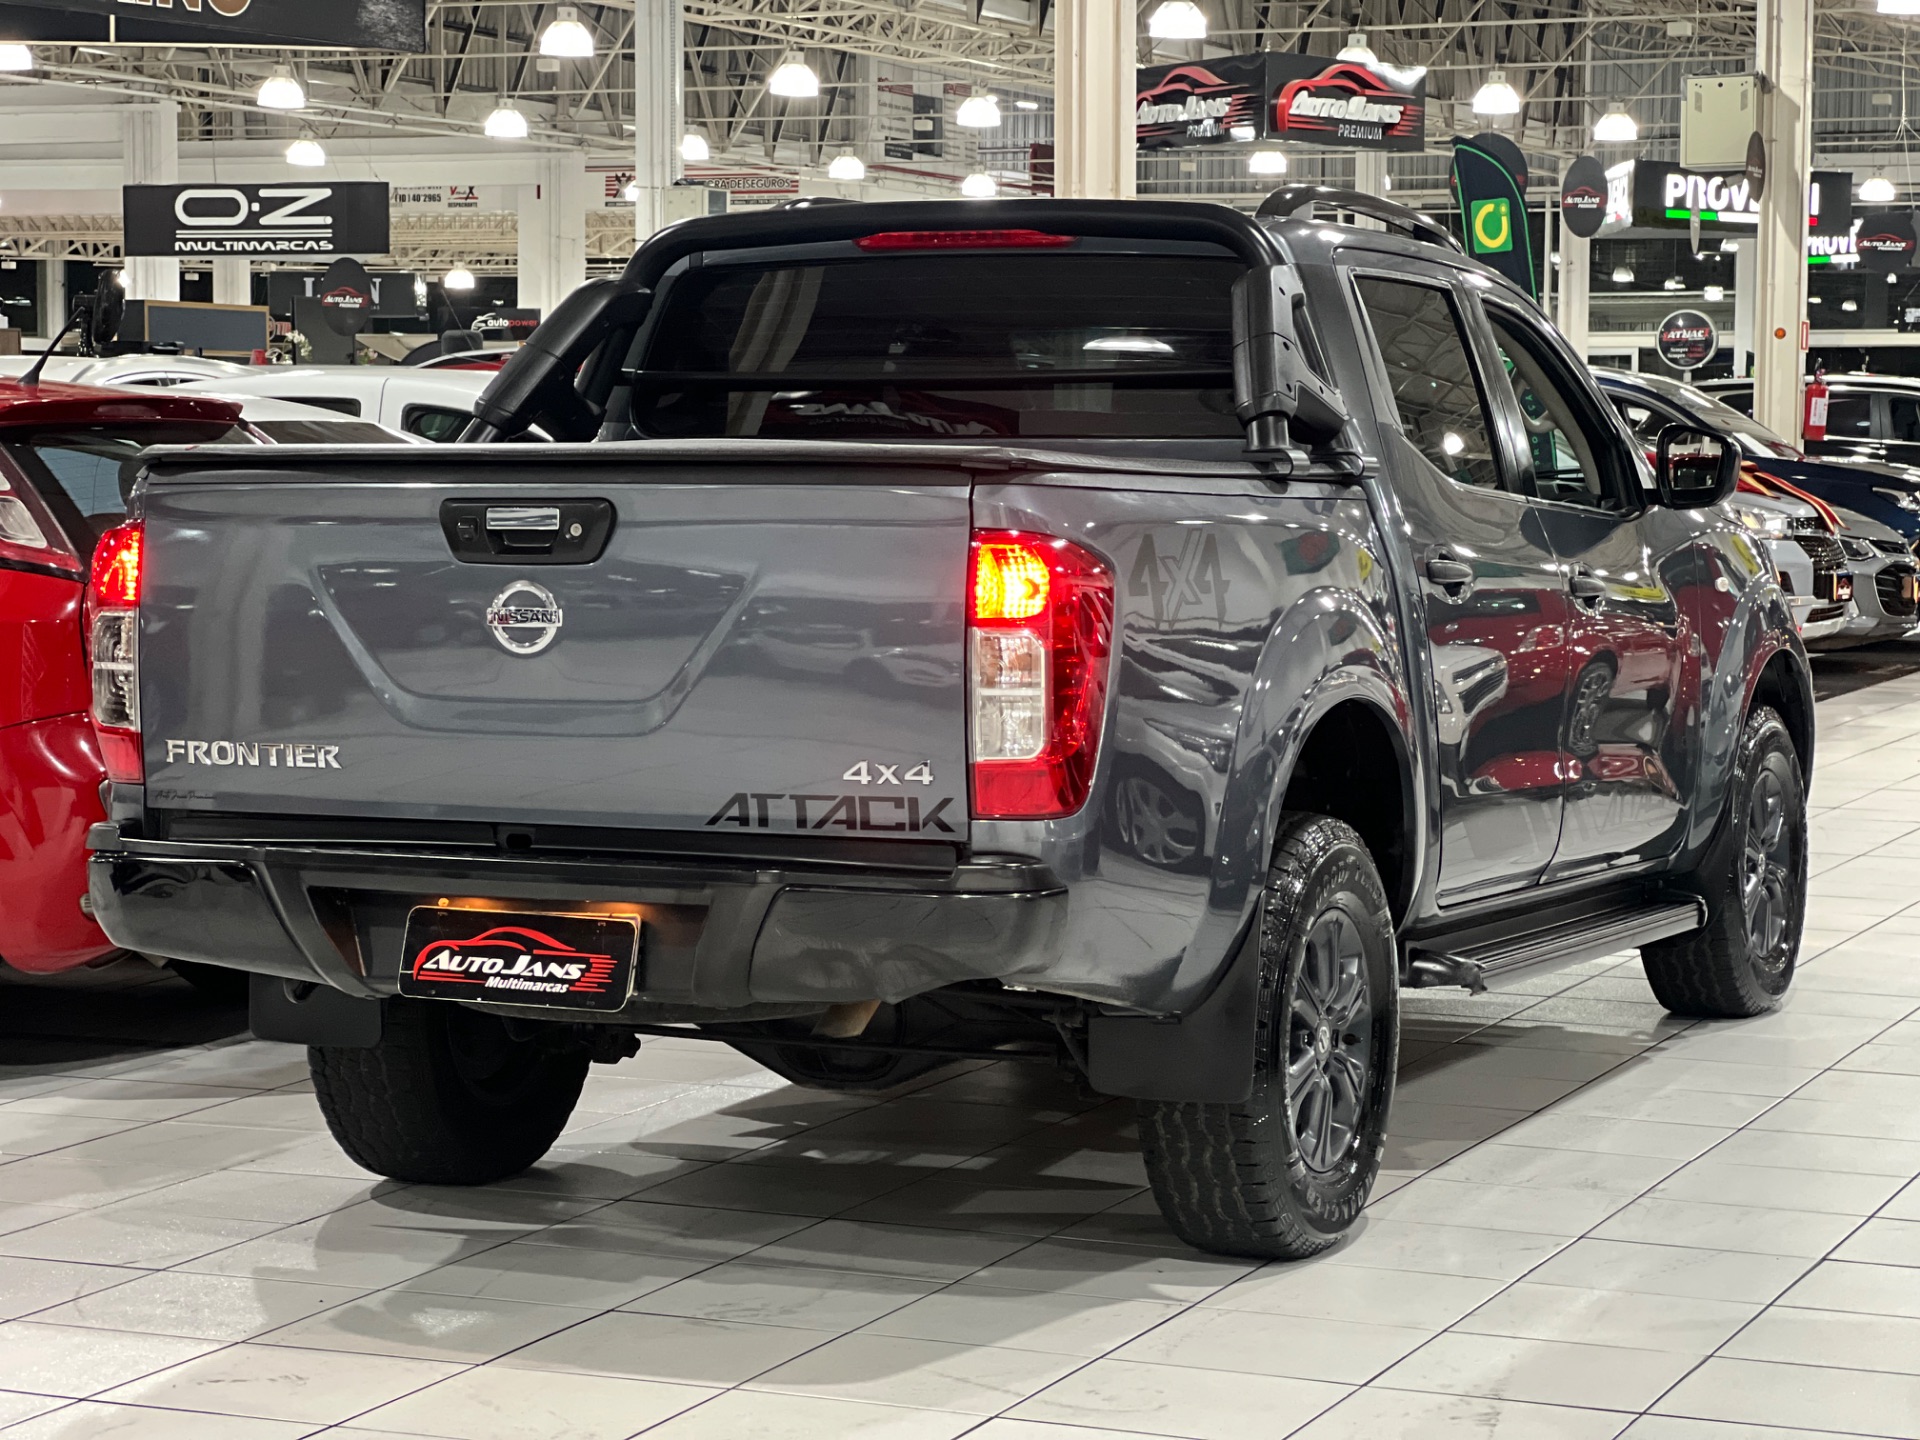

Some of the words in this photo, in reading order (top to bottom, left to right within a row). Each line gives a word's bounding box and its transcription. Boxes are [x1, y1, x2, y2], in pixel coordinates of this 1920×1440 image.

[1338, 124, 1382, 140] PREMIUM
[745, 178, 791, 189] SEGUROS
[174, 240, 334, 251] MULTIMARCAS
[493, 611, 553, 623] NISSAN
[165, 739, 343, 770] FRONTIER
[704, 792, 957, 833] ATTACK
[484, 975, 571, 994] Multimarcas
